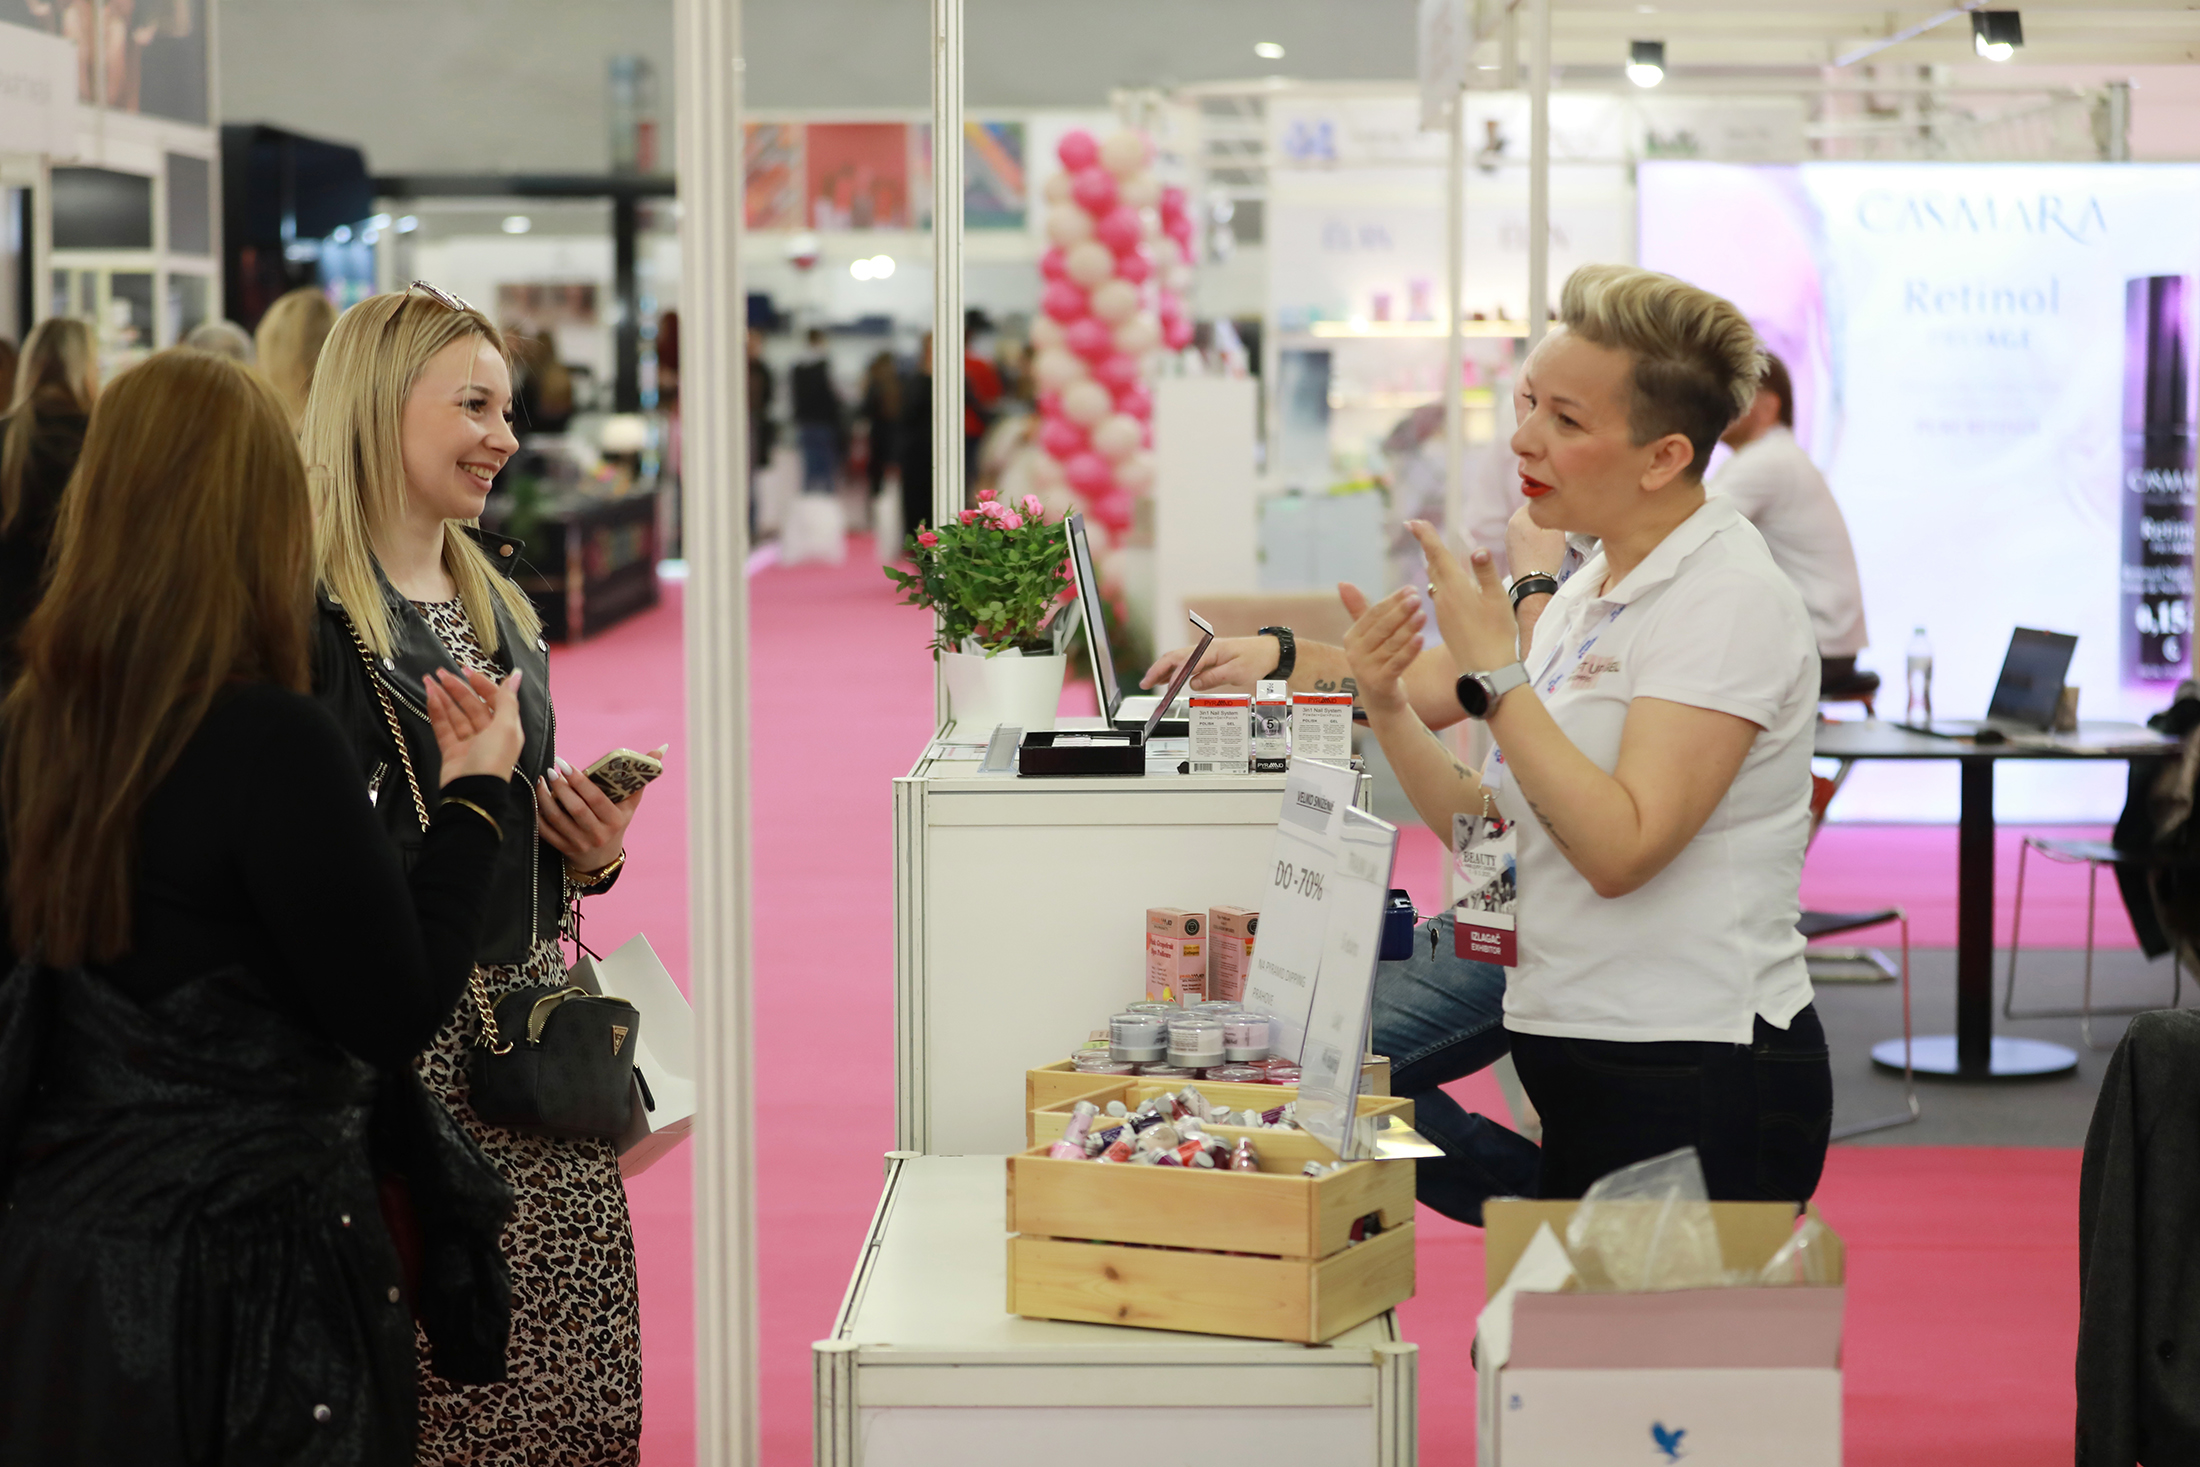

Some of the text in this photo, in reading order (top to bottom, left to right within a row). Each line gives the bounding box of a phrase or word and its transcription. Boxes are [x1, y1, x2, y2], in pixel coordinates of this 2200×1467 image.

[1904, 274, 2059, 315] Retinol
[1266, 719, 1274, 729] 5
[1463, 851, 1497, 866] BEAUTY
[1275, 860, 1293, 890] DO
[1471, 931, 1501, 945] IZLAGAČ
[1471, 943, 1501, 955] EXHIBITOR
